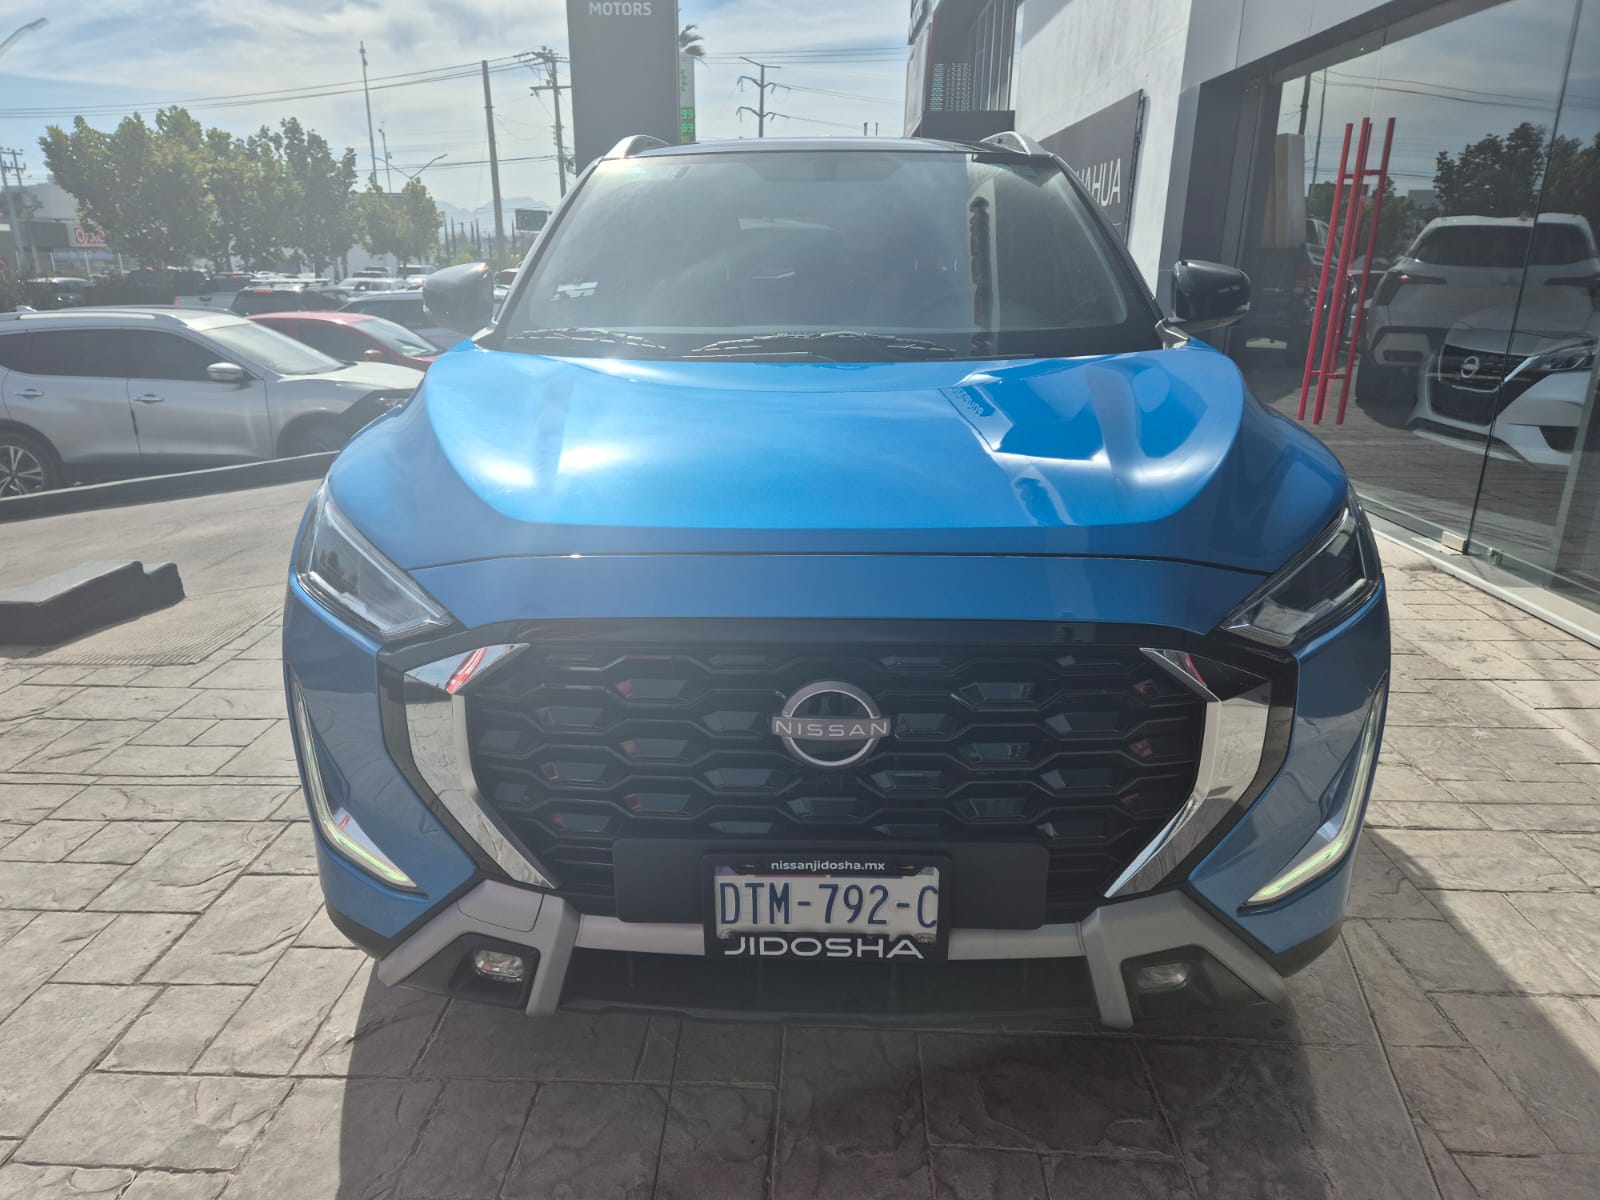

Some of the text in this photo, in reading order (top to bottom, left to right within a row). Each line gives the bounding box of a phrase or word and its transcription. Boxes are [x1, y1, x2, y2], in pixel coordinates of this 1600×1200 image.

[588, 1, 652, 16] MOTORS
[775, 720, 887, 737] NISSAN
[770, 860, 885, 871] nissanjidosha.mx
[719, 882, 938, 928] DTM-792-C
[724, 936, 924, 959] JIDOSHA
